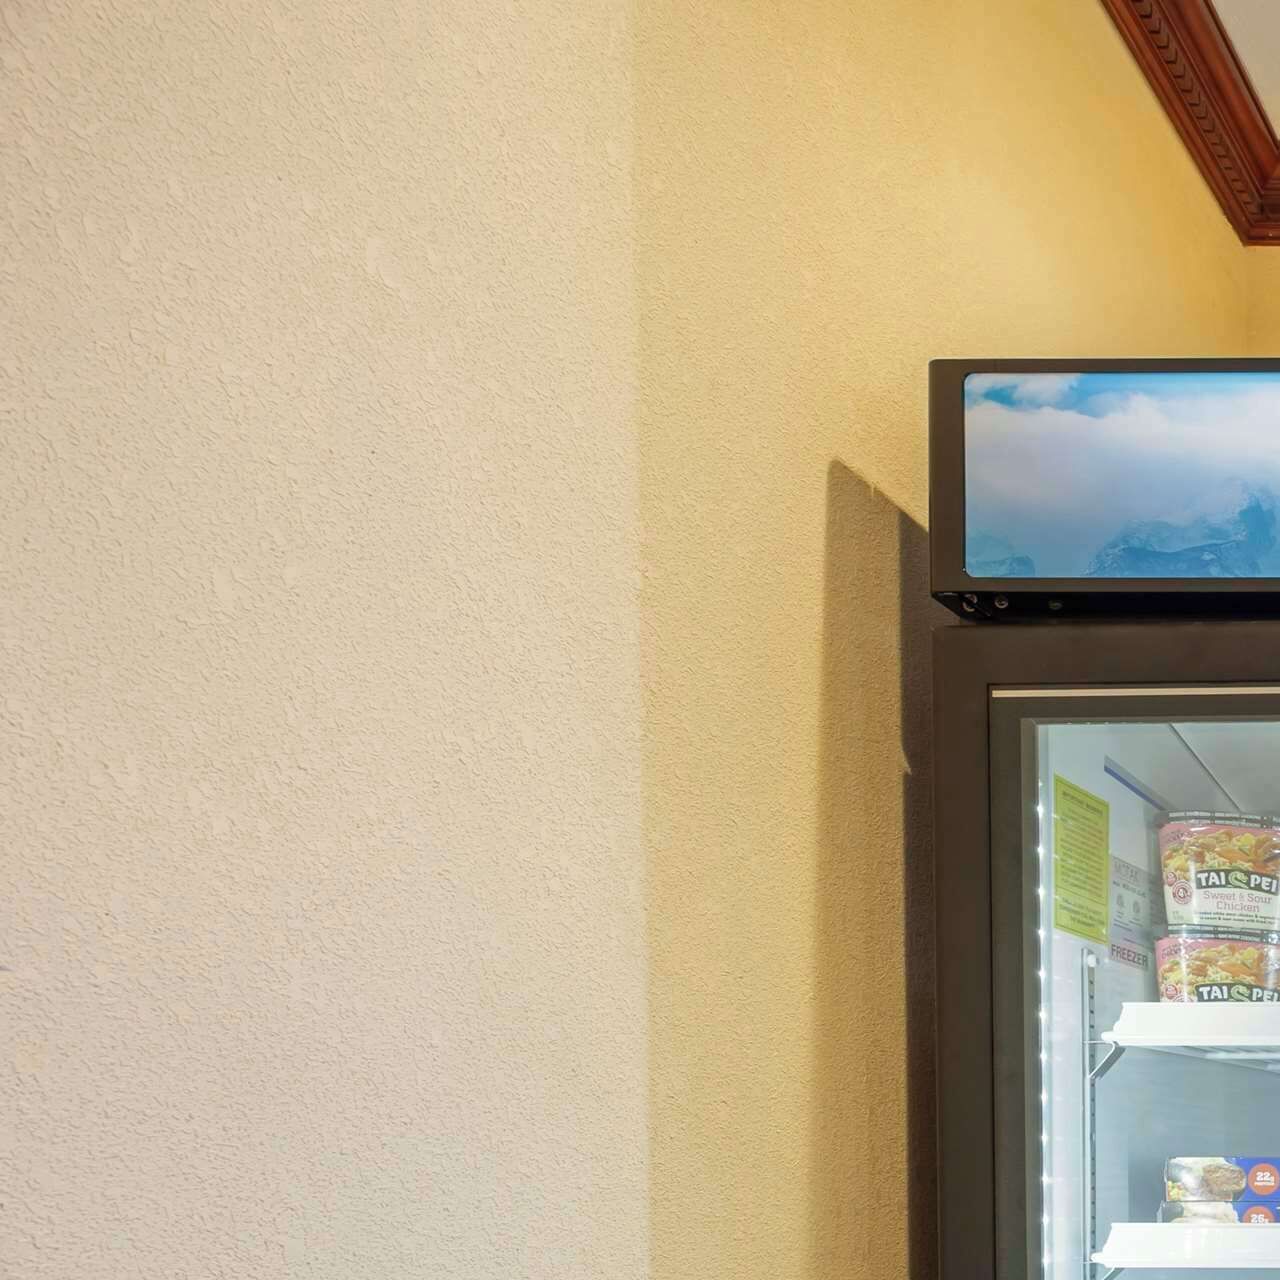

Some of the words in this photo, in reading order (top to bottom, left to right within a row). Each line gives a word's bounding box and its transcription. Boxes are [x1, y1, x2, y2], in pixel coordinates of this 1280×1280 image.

[1196, 872, 1226, 887] TAI
[1250, 875, 1279, 892] PEI
[1202, 890, 1236, 902] Sweet
[1246, 894, 1272, 904] Sour
[1216, 900, 1260, 912] Chicken
[1110, 944, 1149, 968] FREEZER
[1198, 986, 1228, 1000] TAI
[1252, 990, 1279, 1002] PEI
[1256, 1172, 1275, 1182] 22g
